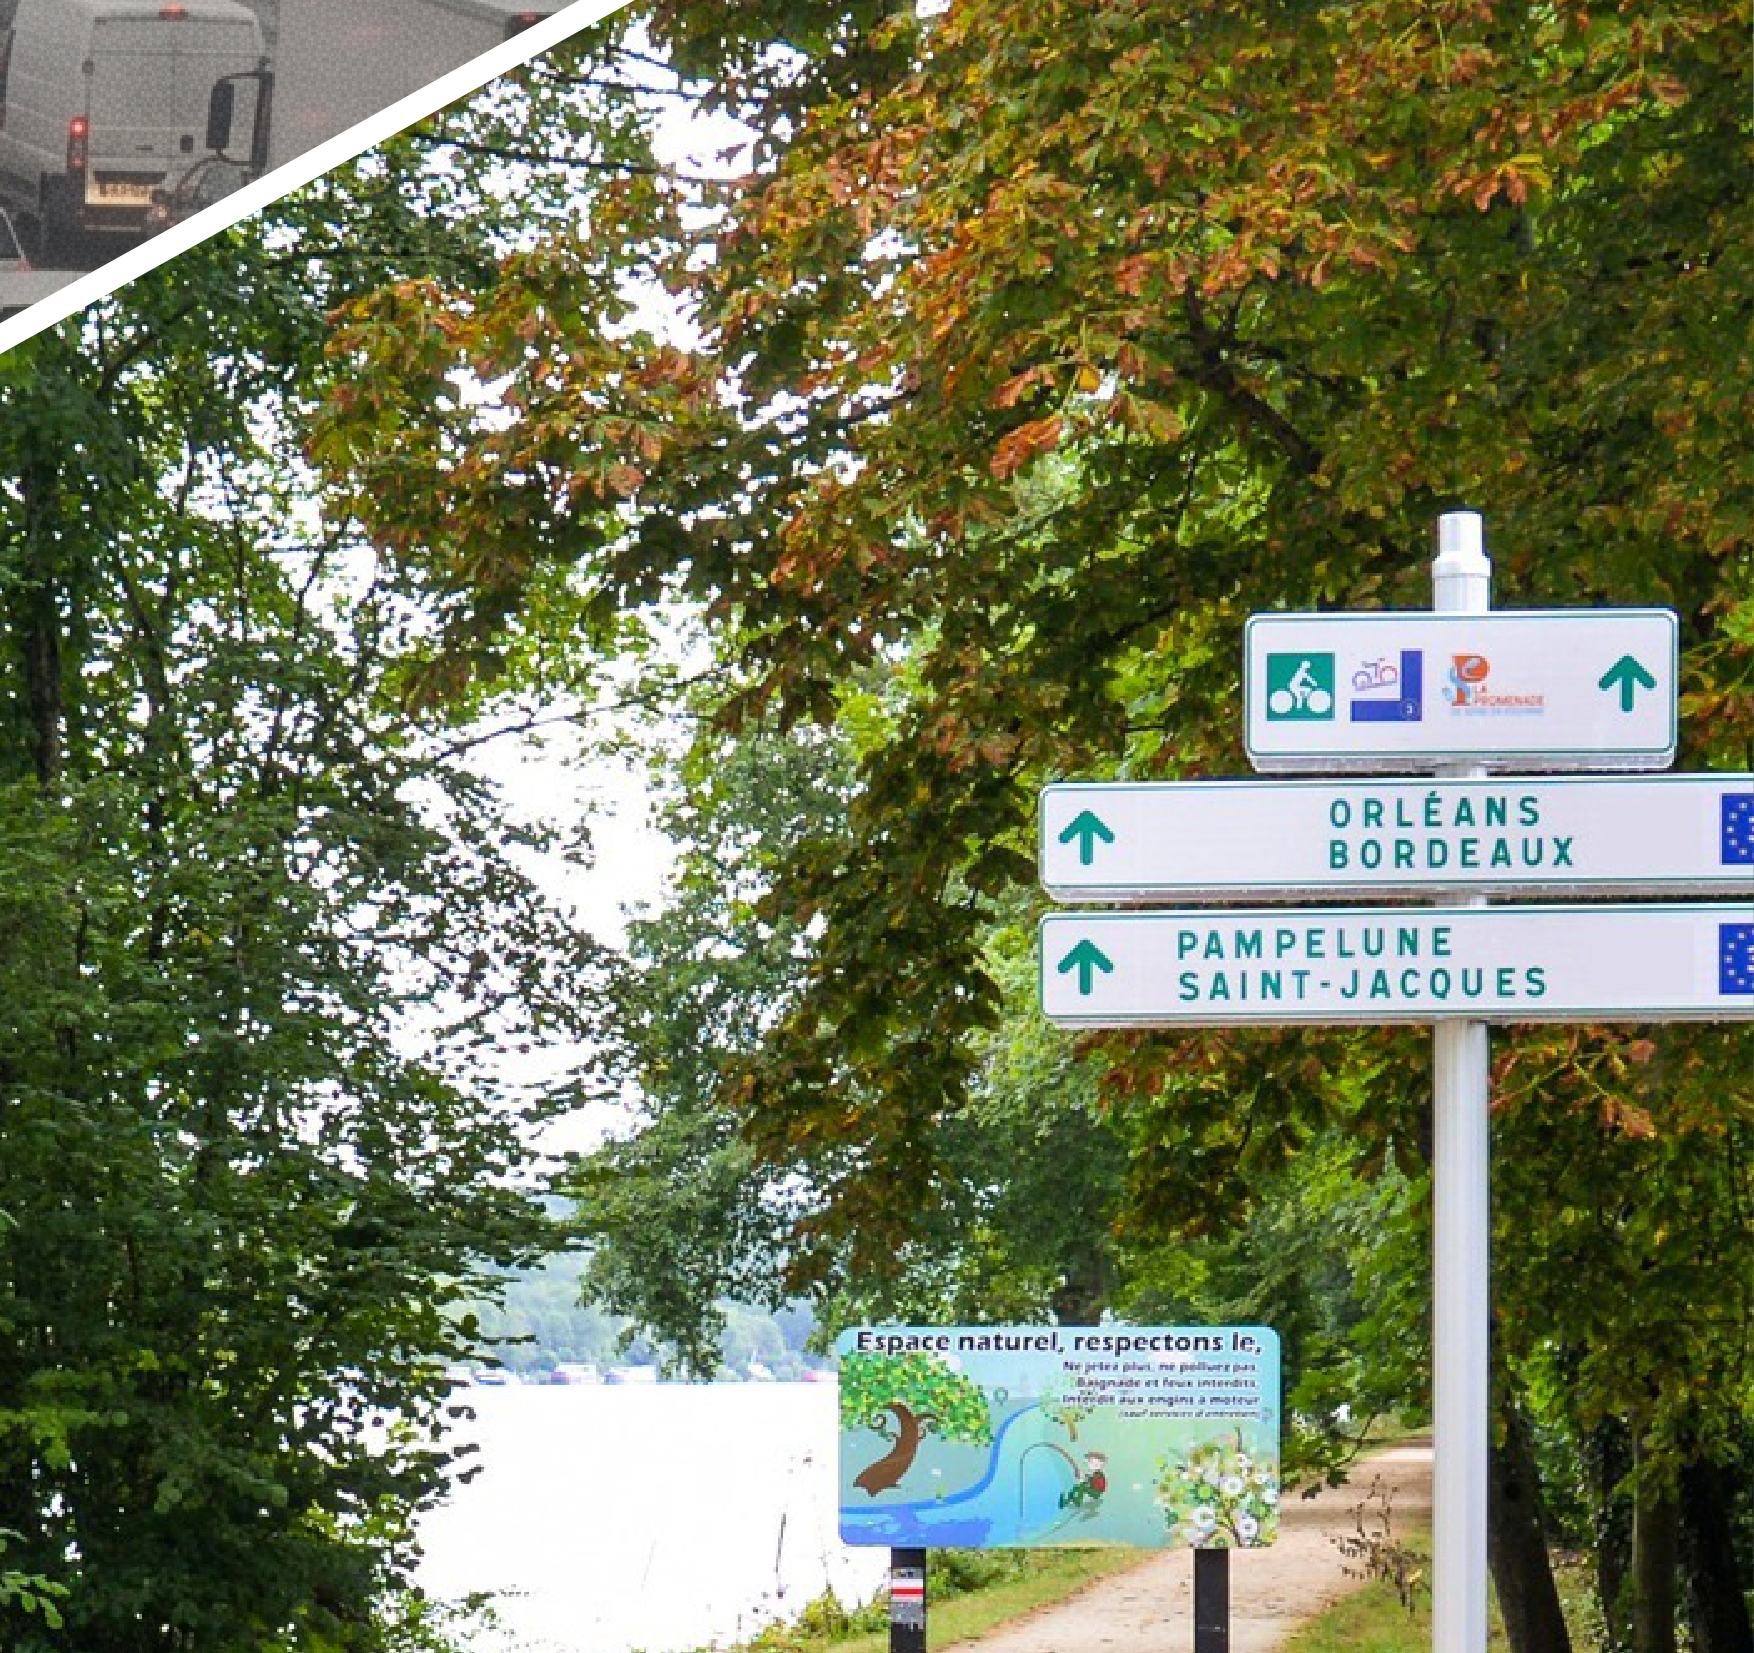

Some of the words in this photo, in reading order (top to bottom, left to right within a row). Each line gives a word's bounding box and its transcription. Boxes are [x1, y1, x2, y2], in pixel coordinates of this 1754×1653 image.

[1329, 791, 1541, 828] ORLÉANS
[1329, 837, 1574, 870] BORDEAUX
[1177, 928, 1453, 960] PAMPELUNE
[1178, 968, 1547, 1001] SAINT-JACQUES
[857, 1331, 950, 1354] Espace
[958, 1331, 1065, 1354] naturel,
[1074, 1332, 1226, 1354] respectons
[1232, 1331, 1262, 1355] le,
